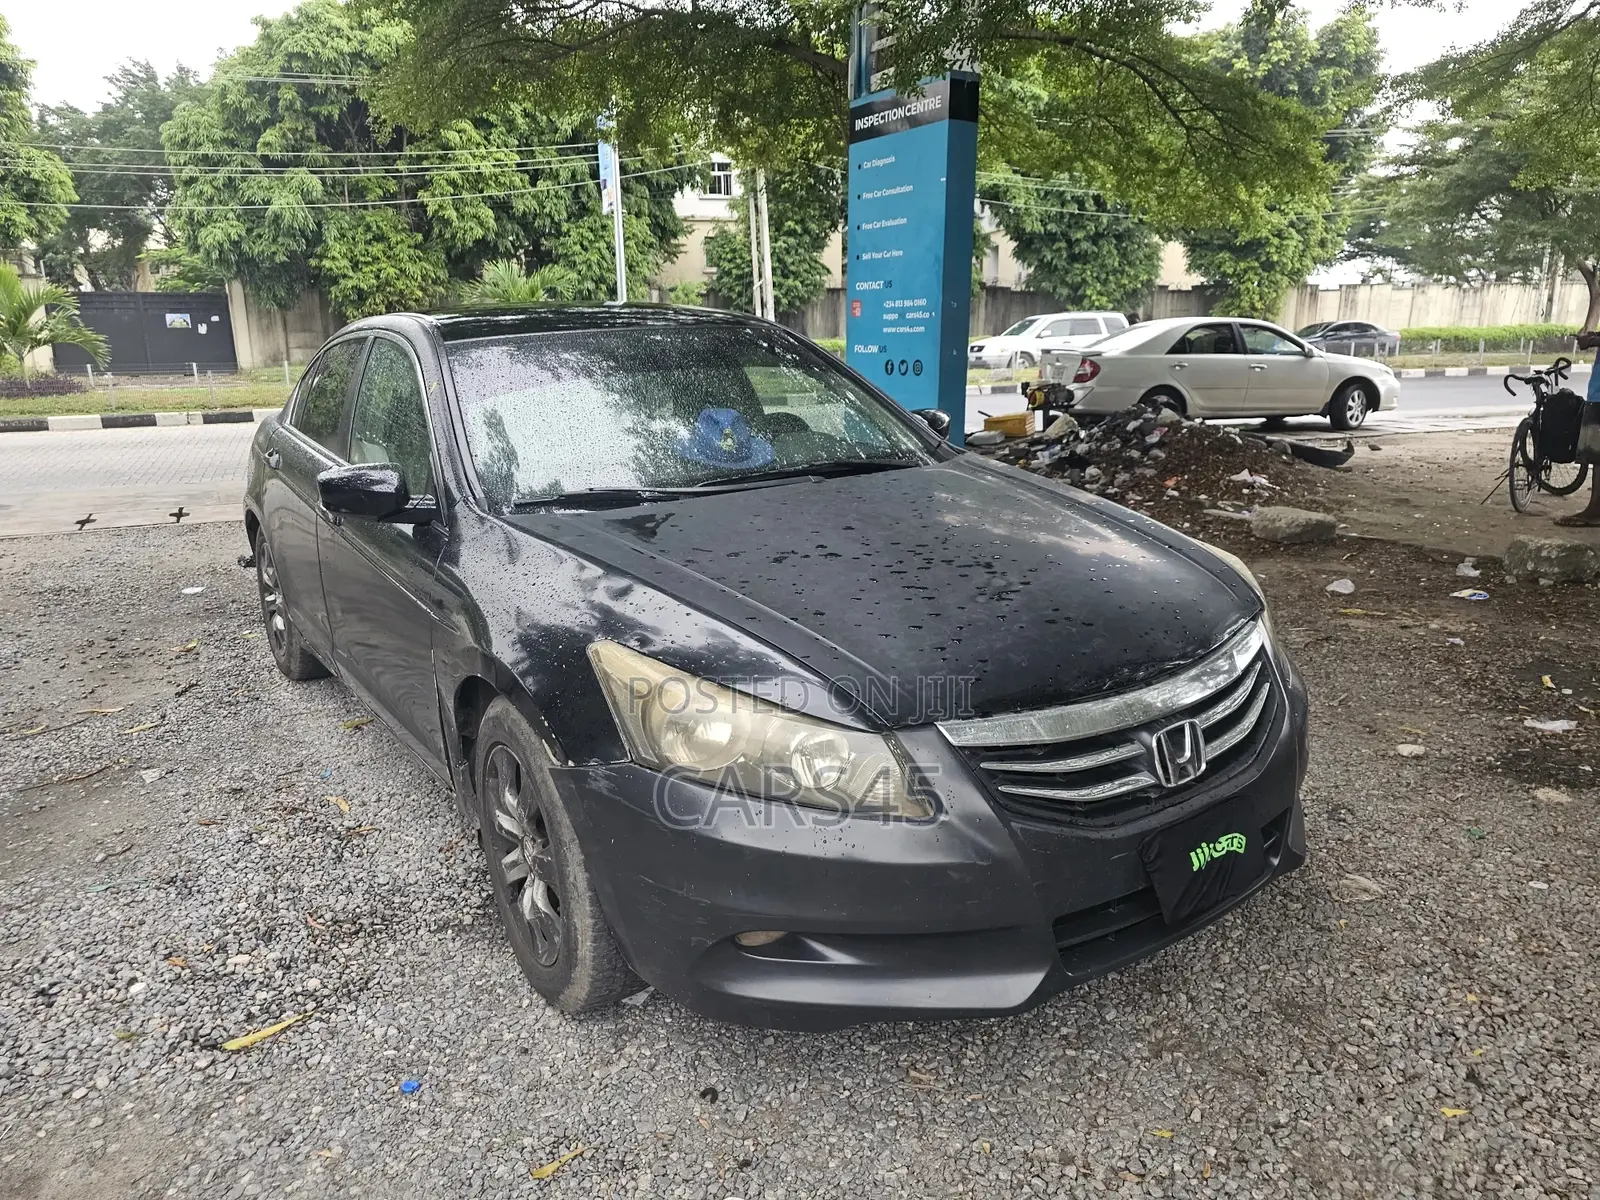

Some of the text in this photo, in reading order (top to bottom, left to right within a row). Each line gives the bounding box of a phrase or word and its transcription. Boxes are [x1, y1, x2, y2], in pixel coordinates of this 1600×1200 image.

[855, 95, 942, 131] INSPECTION CENTRE
[863, 155, 895, 169] Car Diagnosis
[862, 184, 913, 200] Free Car Consultation
[862, 217, 907, 231] Free Car Evaluation
[862, 249, 903, 260] Sell Your Car Here
[856, 280, 892, 290] CONTACT US
[879, 345, 887, 353] US
